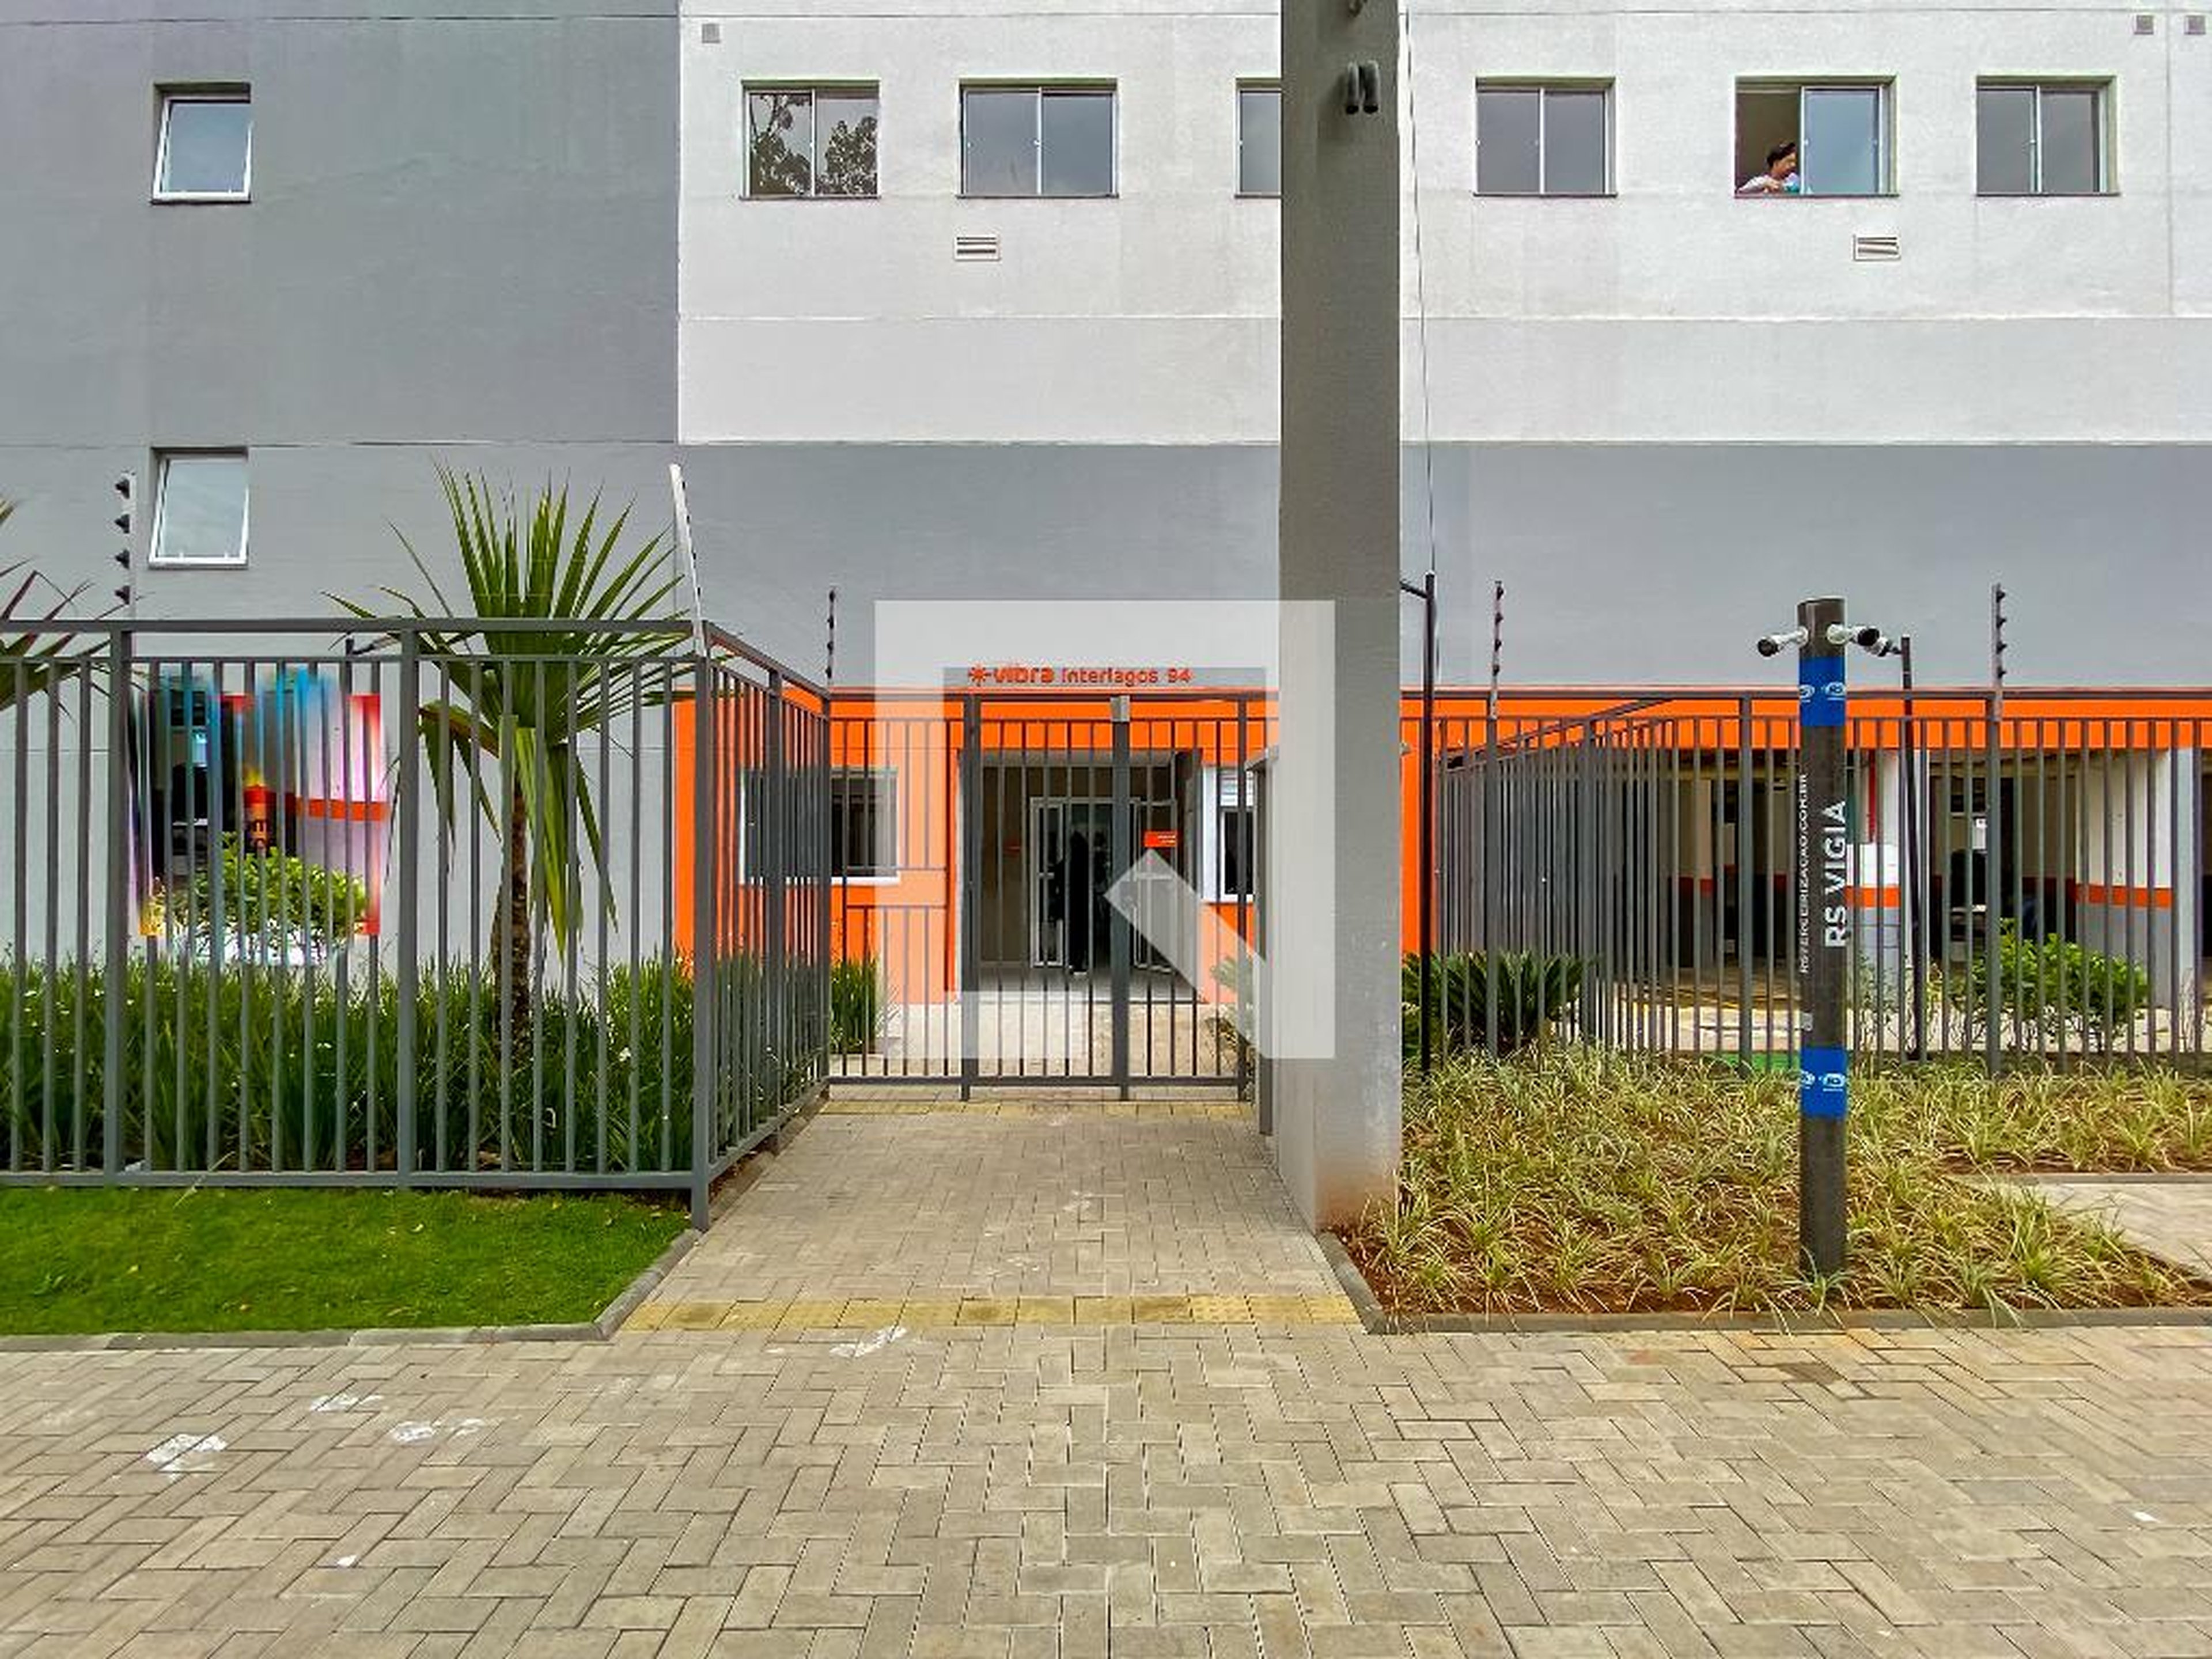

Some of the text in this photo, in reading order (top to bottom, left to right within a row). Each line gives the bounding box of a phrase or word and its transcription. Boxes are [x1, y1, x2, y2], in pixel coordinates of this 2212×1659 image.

[1062, 668, 1158, 687] Interlagos
[1167, 668, 1192, 683] 94
[1823, 800, 1847, 947] RS VIGIA
